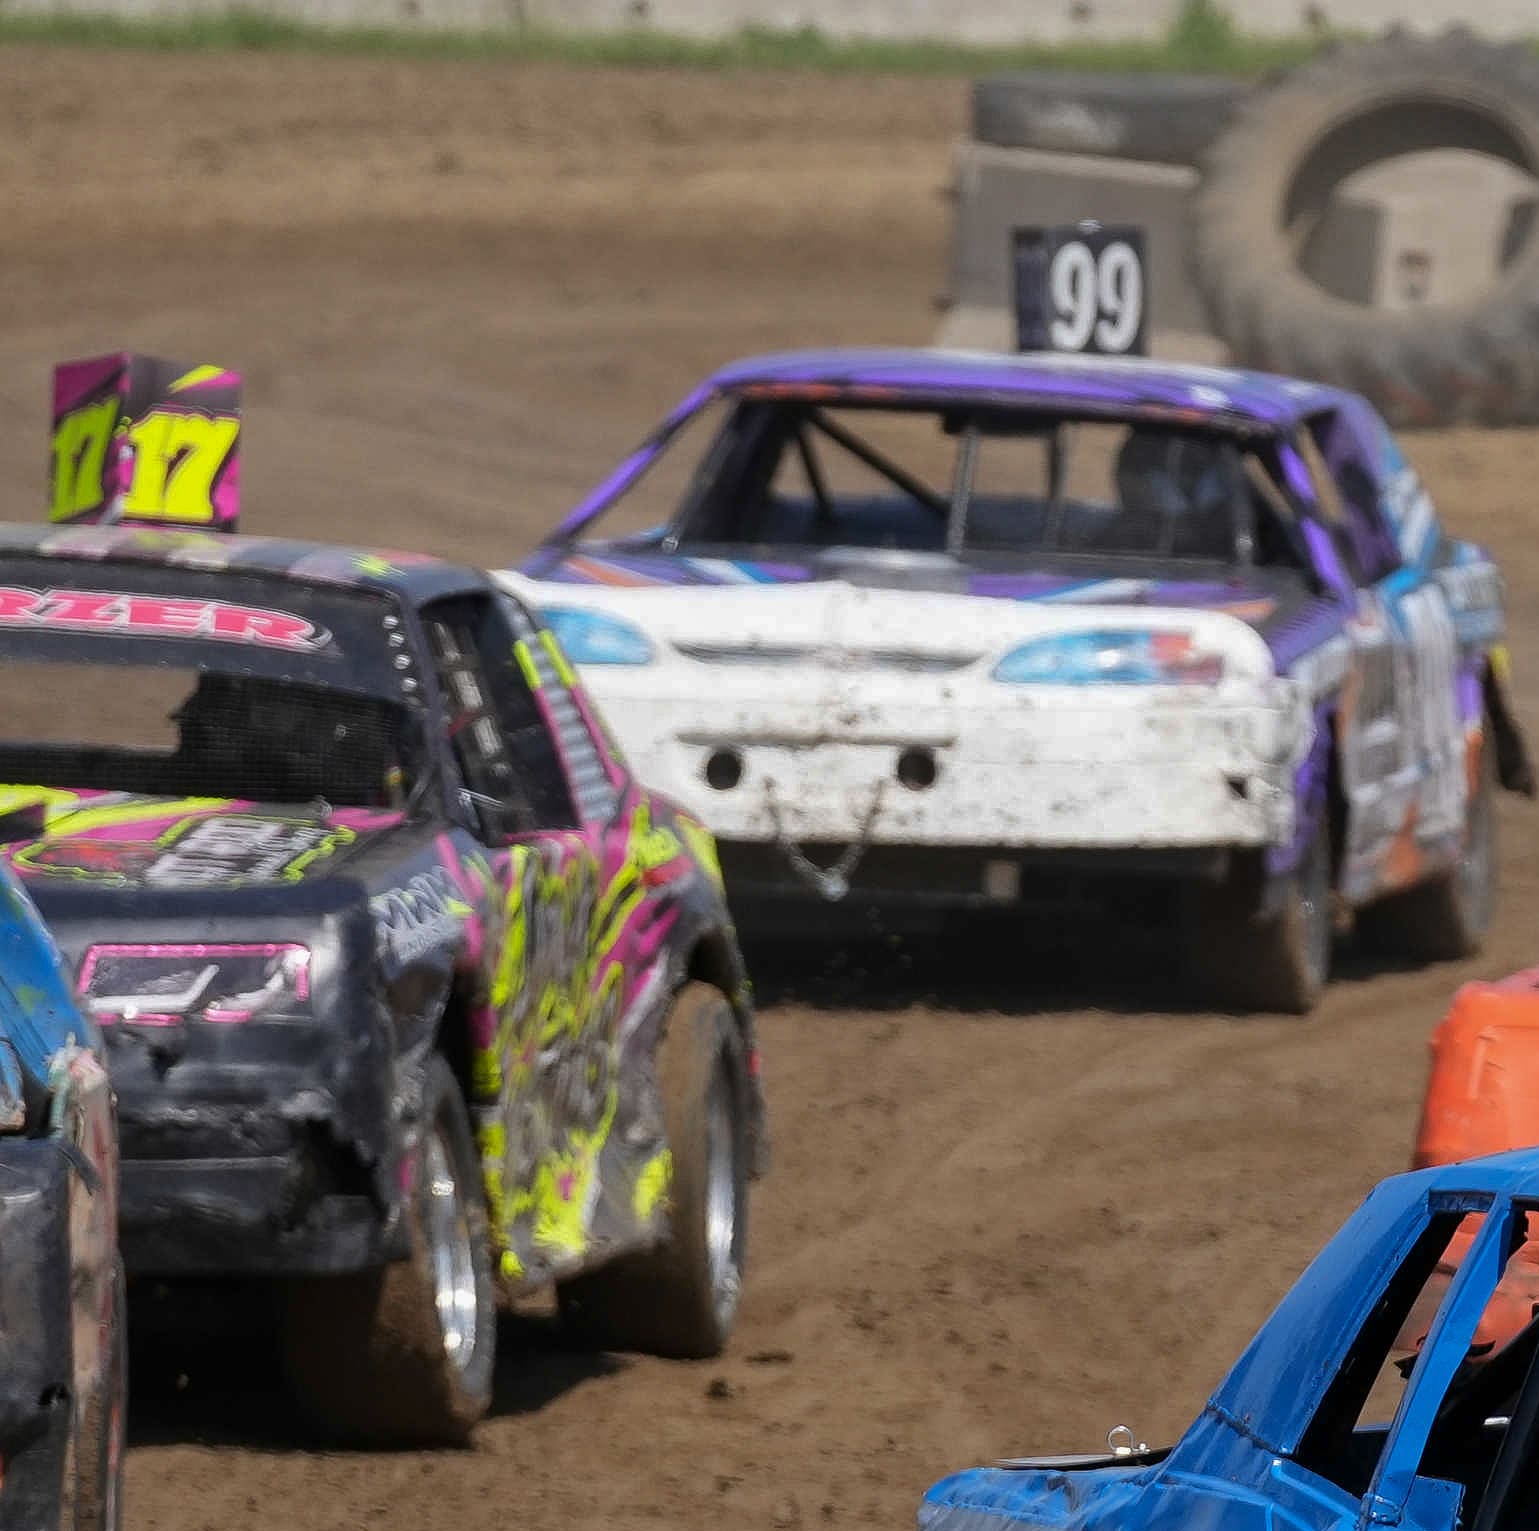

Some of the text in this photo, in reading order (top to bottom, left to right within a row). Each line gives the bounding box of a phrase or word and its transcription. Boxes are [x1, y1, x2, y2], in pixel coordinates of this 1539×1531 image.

[1050, 241, 1143, 352] 99
[49, 395, 120, 521] 17
[122, 410, 240, 522] 17
